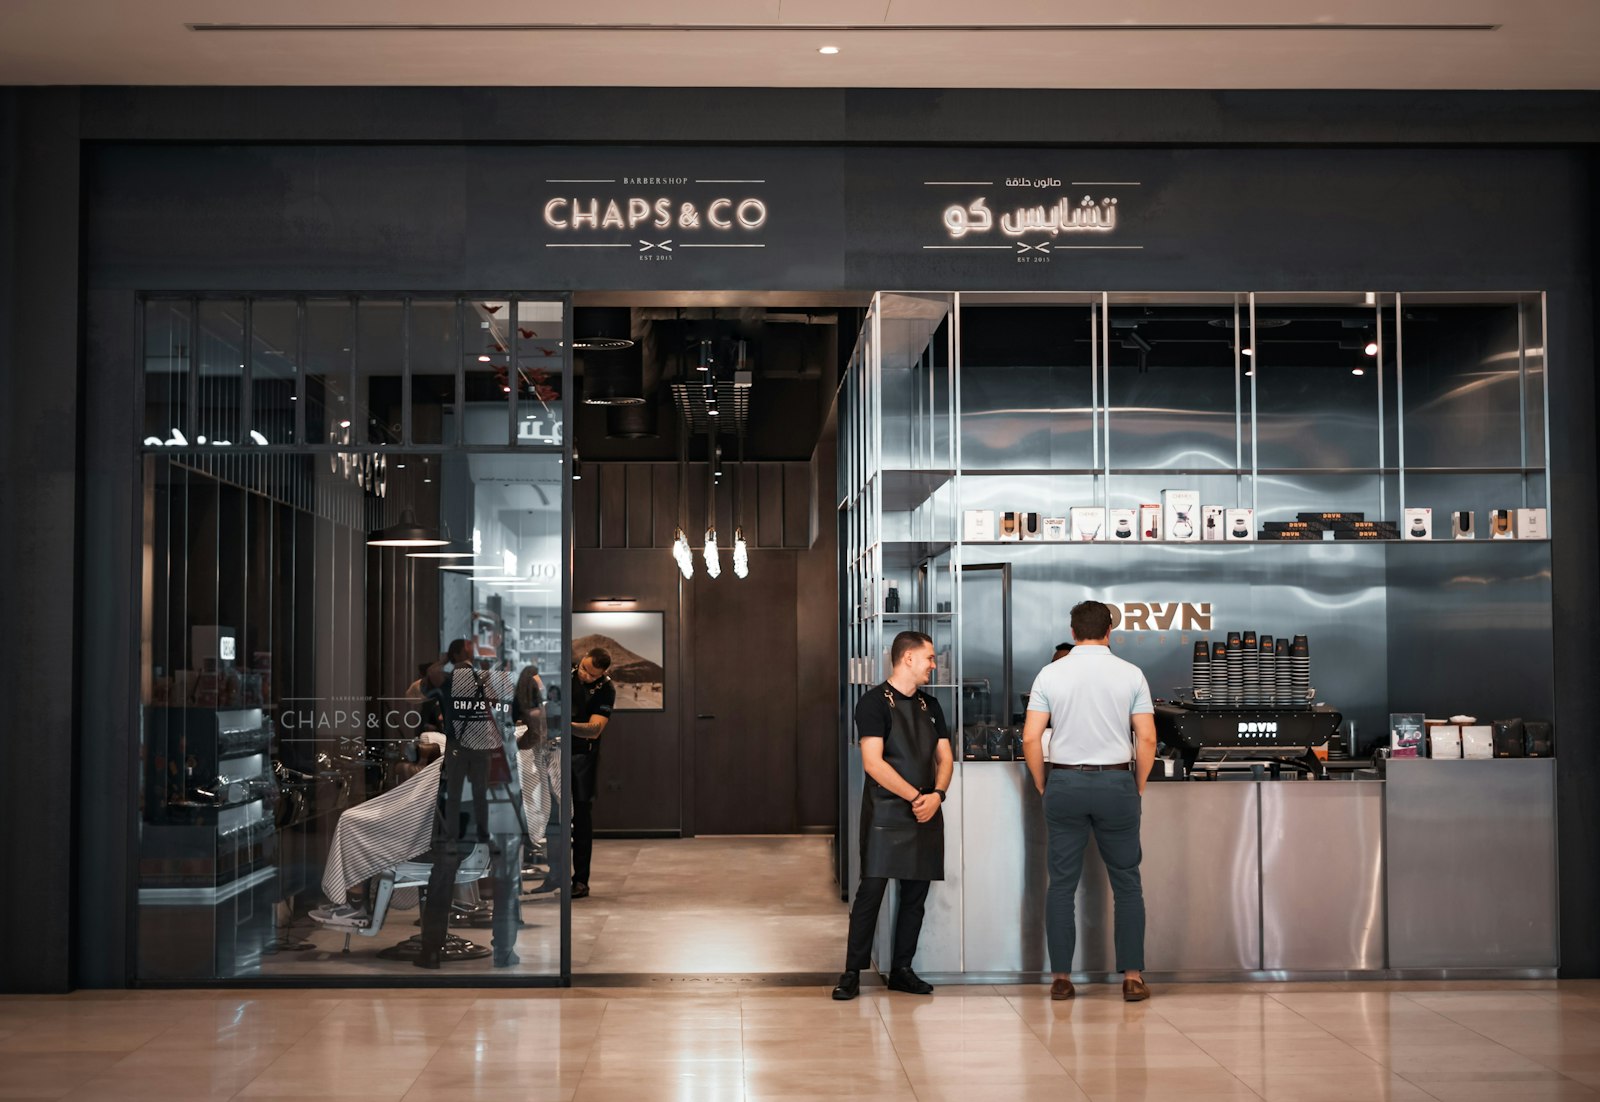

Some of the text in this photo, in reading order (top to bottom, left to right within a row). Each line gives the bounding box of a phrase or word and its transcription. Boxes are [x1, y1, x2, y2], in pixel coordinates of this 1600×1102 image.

[623, 177, 689, 185] BARBERSHOP
[1005, 177, 1062, 189] صالون حلاقة
[944, 195, 1118, 238] تشابس كو
